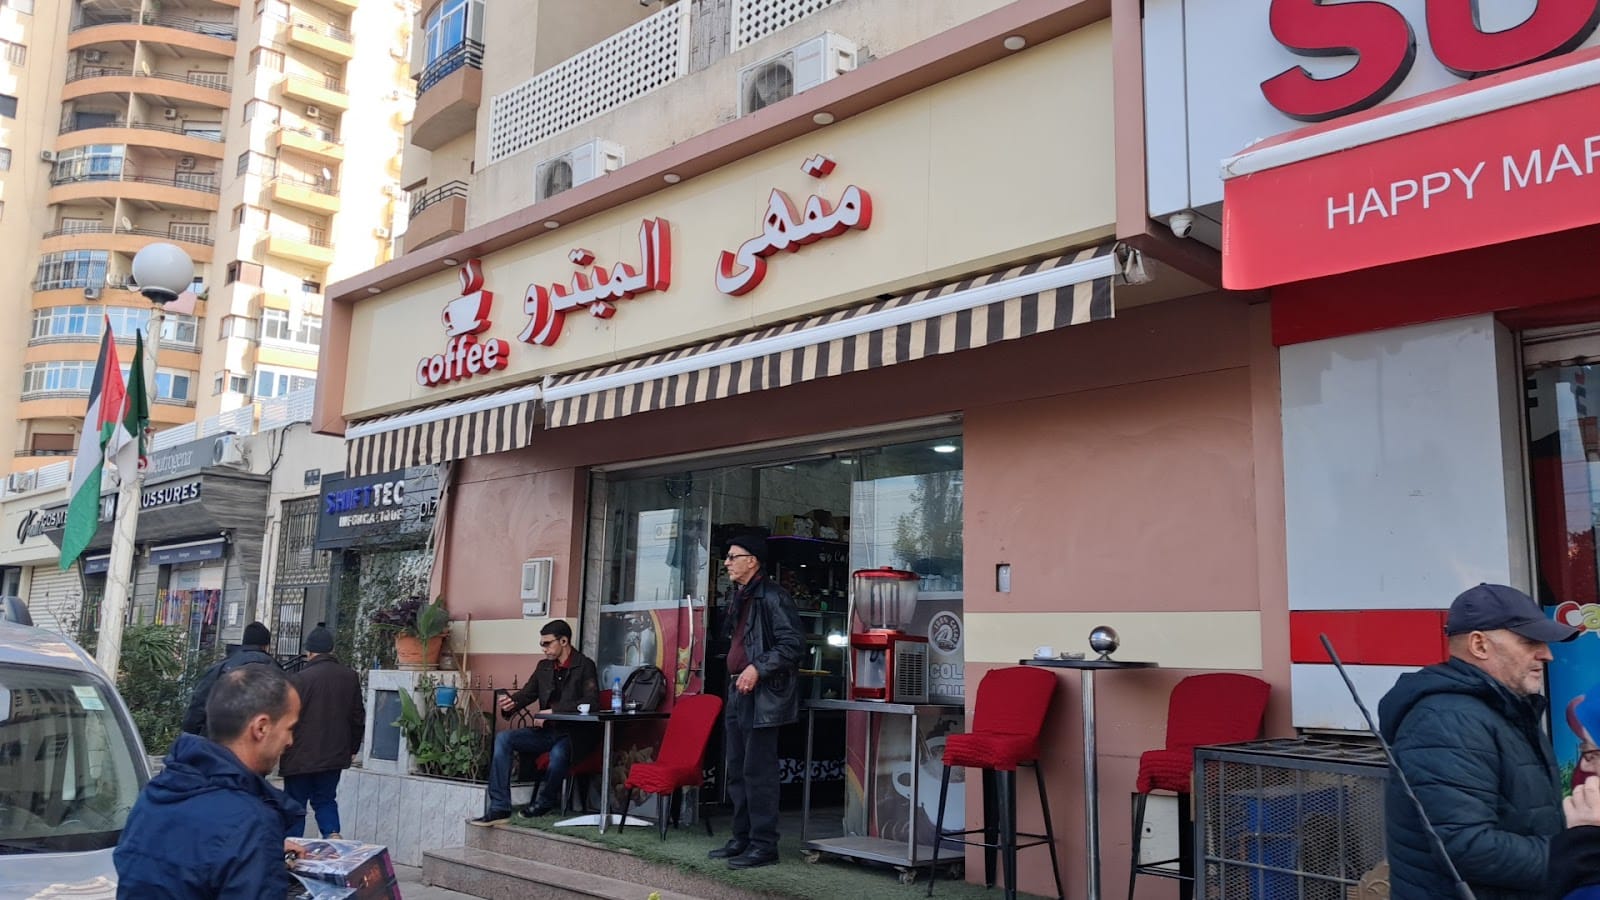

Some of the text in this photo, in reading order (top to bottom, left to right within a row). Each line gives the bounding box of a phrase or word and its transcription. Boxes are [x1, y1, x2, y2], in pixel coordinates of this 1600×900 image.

[1326, 161, 1486, 230] HAPPY
[518, 154, 872, 346] مقهى الميترو
[416, 335, 507, 387] coffee
[142, 482, 198, 508] USSURES
